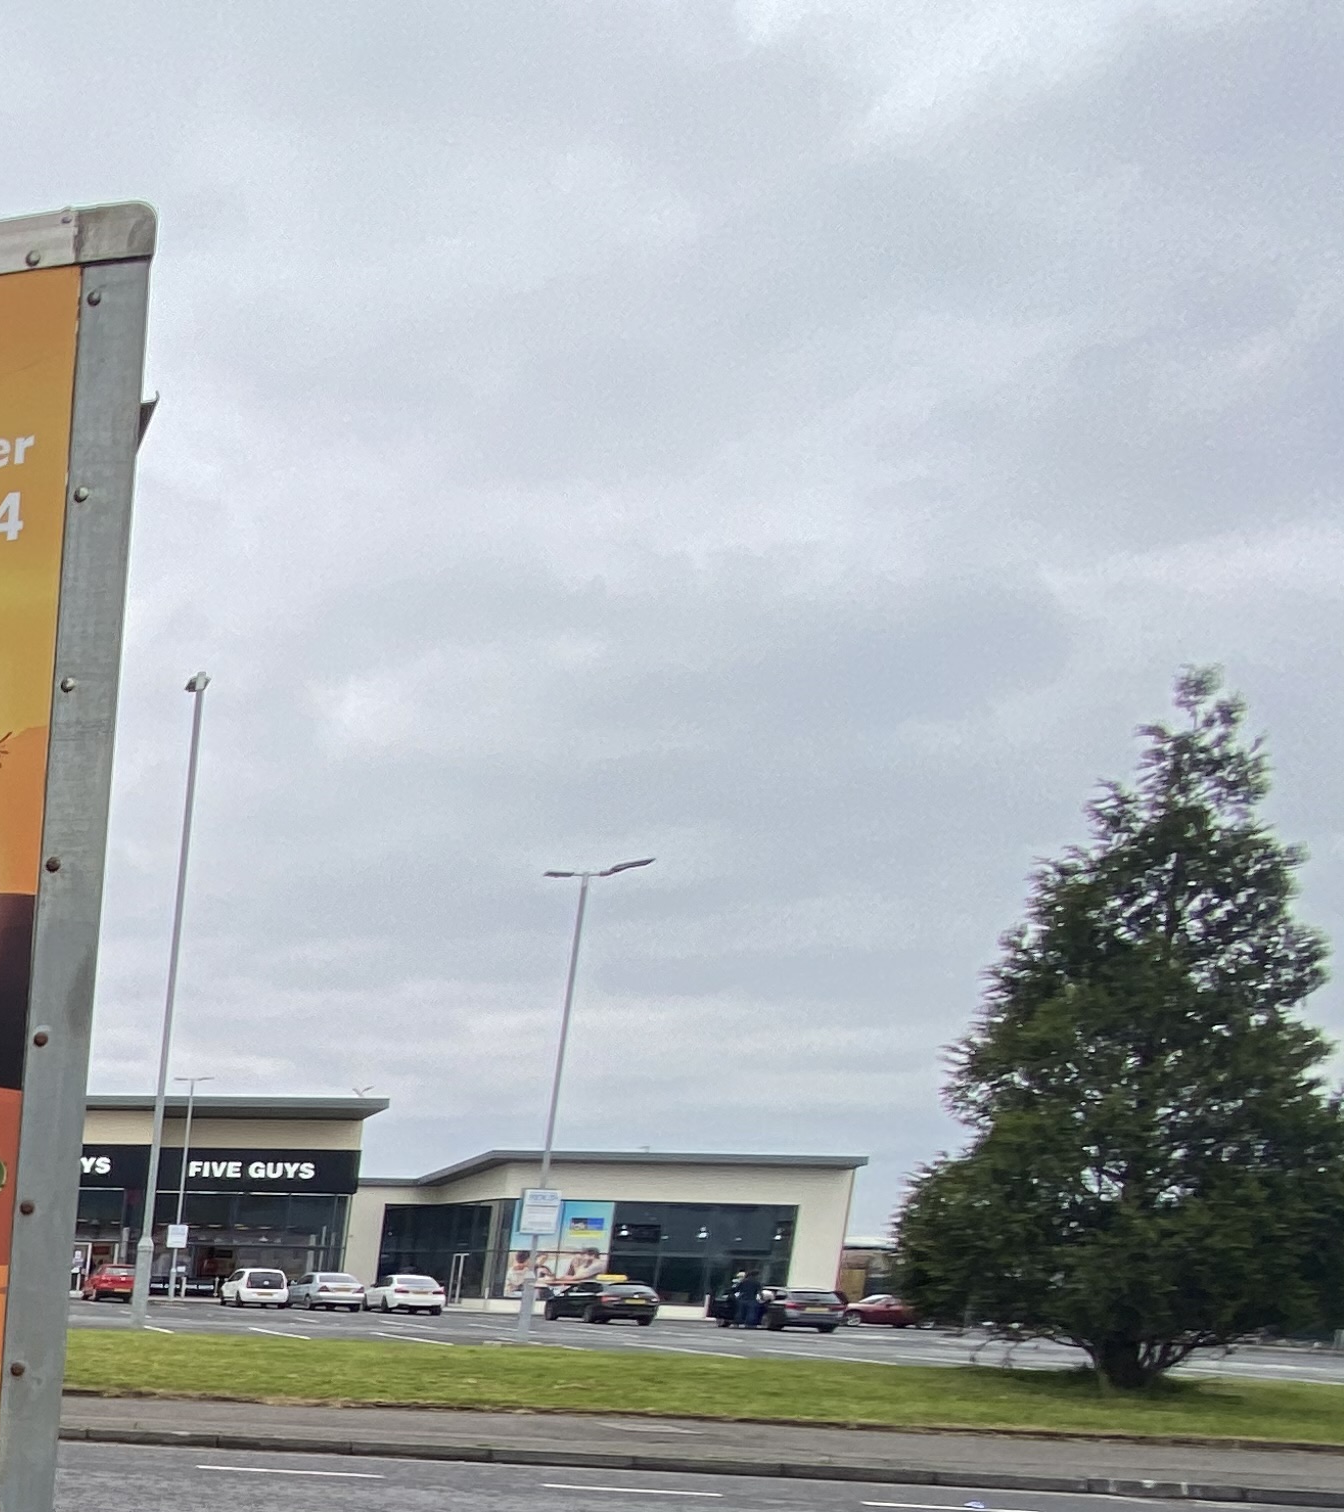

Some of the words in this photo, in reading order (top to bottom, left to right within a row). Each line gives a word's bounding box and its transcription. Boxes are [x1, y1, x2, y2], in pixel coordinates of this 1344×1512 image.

[79, 1156, 112, 1175] YS
[187, 1160, 242, 1178] FIVE
[248, 1161, 316, 1179] GUYS
